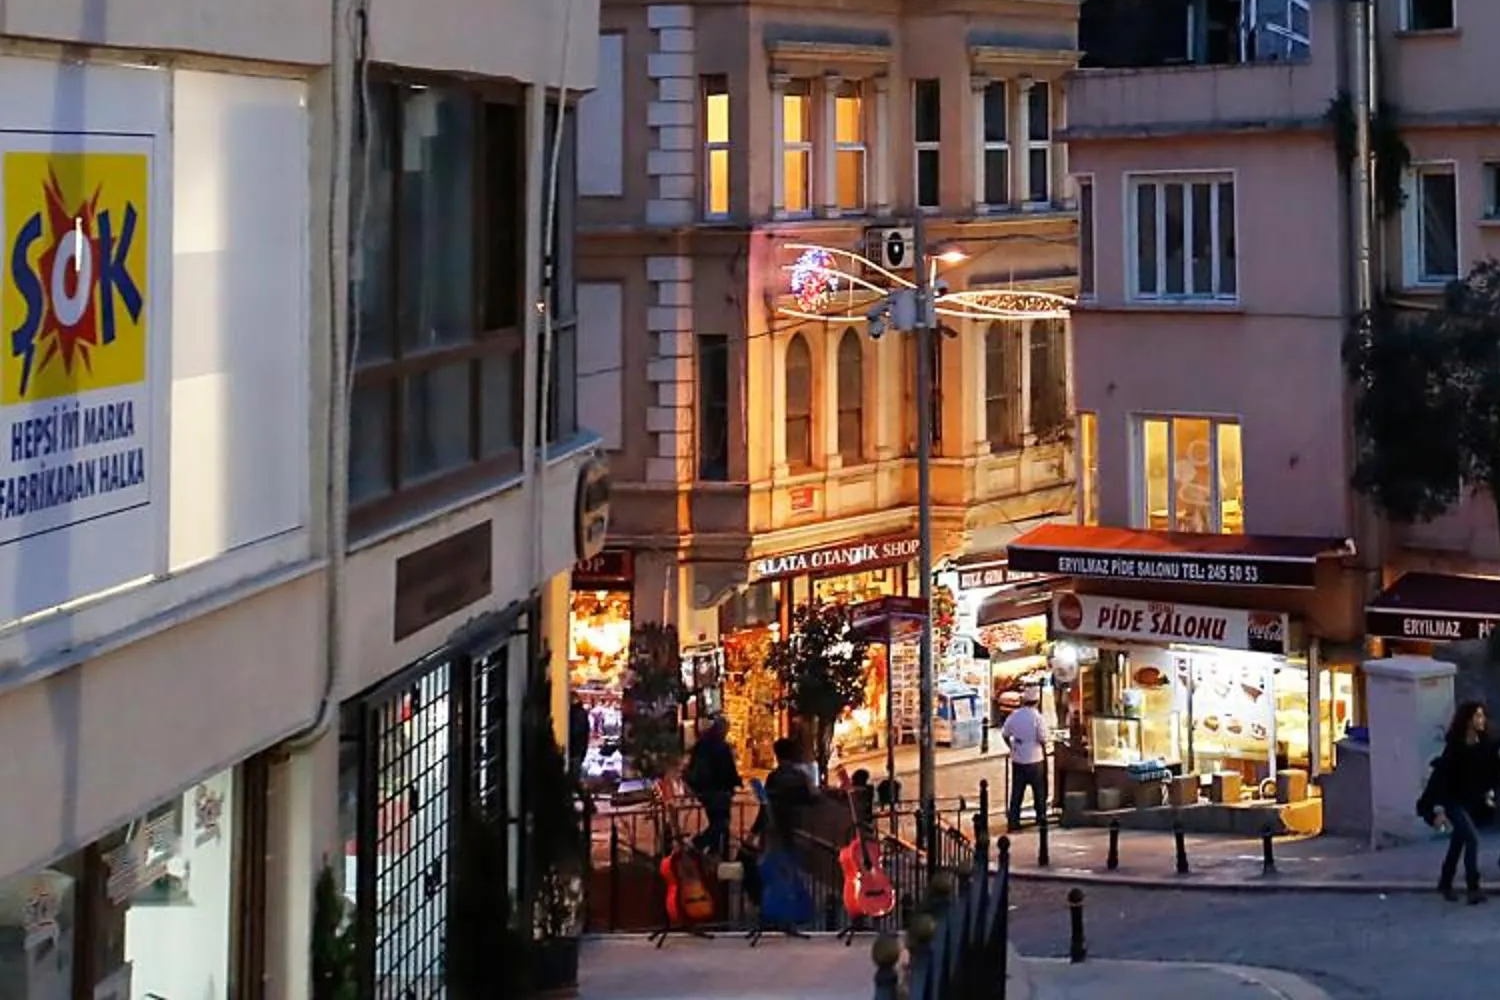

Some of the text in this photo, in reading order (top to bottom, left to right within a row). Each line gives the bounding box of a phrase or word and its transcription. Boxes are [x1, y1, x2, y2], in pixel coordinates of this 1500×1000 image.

[11, 200, 143, 398] ŞOK
[11, 400, 135, 462] HEPSİ İYİ MARKA
[99, 447, 145, 494] HALKA
[757, 539, 921, 575] ALATA OTANTİK SHOP
[1058, 556, 1110, 576] ERYILMAZ
[1111, 557, 1135, 577] PİDE
[1137, 563, 1180, 579] SALONU
[1182, 564, 1205, 579] TEL:
[1207, 564, 1227, 580] 245
[1229, 565, 1243, 582] 50
[1245, 565, 1258, 582] 53
[1097, 603, 1144, 633] PİDE
[1149, 610, 1228, 641] SALONU
[1403, 617, 1462, 637] ERYILMAZ
